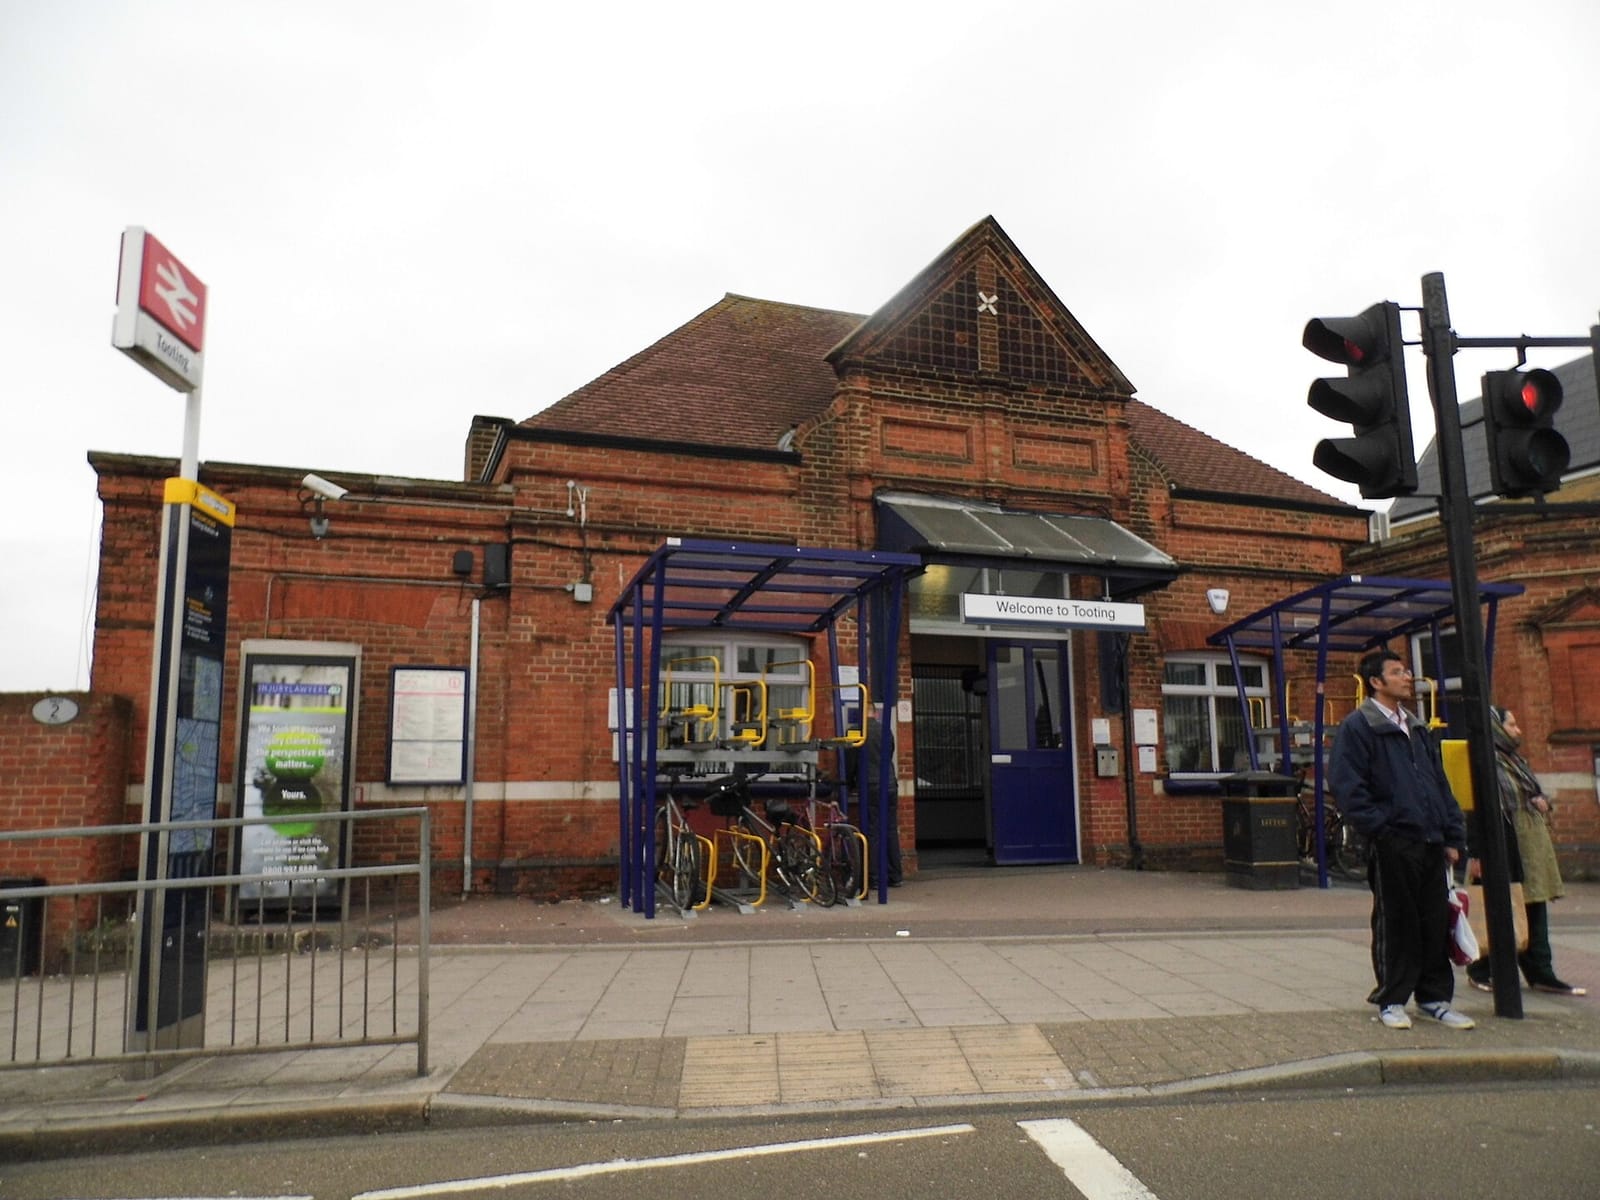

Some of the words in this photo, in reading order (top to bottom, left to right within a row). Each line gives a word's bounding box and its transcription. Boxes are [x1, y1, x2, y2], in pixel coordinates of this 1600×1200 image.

[156, 331, 190, 374] Tooting
[996, 601, 1054, 616] Welcome
[1056, 605, 1069, 617] to
[1071, 605, 1116, 622] Tooting
[51, 703, 60, 718] 2
[270, 748, 316, 759] perspective
[318, 748, 335, 757] that
[281, 788, 306, 799] Yours.
